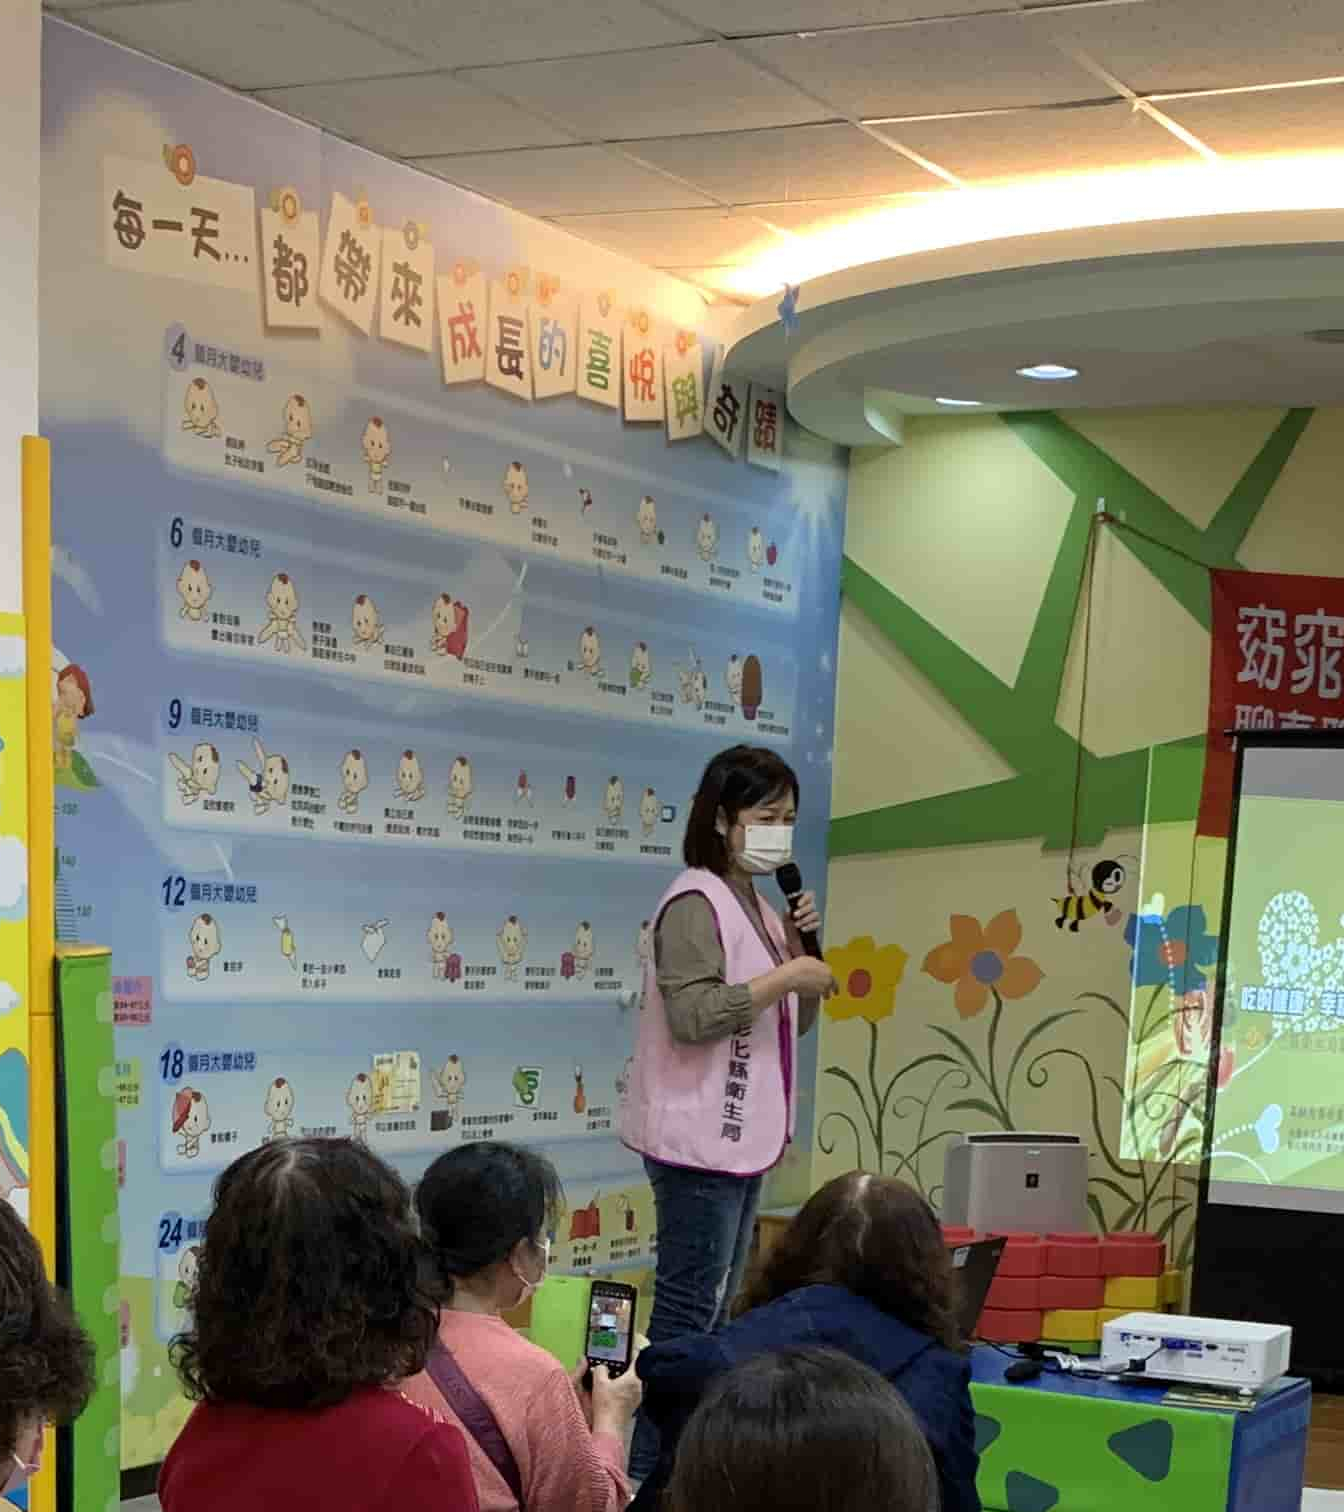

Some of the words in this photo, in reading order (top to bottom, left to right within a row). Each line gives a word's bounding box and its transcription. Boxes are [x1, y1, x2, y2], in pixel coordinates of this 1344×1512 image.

[170, 332, 186, 366] 4
[169, 517, 184, 549] 6
[168, 698, 182, 729] 9
[161, 875, 186, 907] 12
[159, 1048, 185, 1080] 18
[158, 1217, 184, 1249] 24
